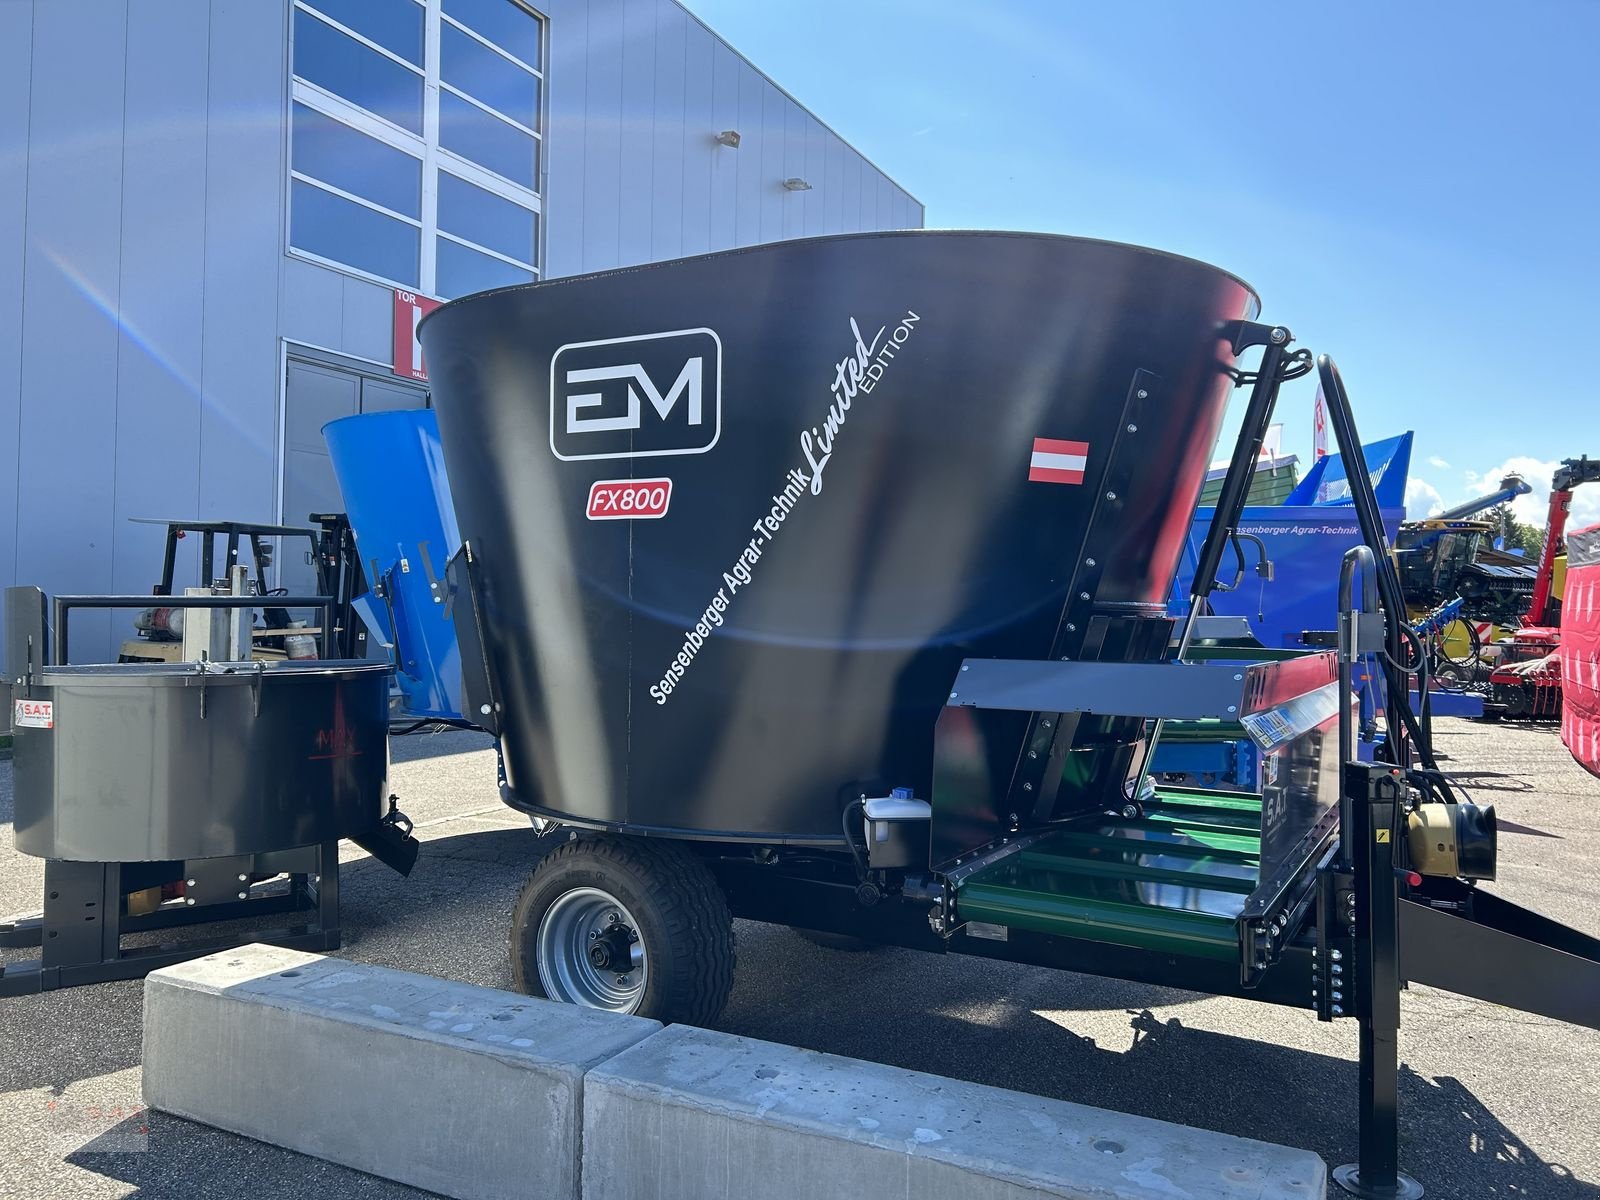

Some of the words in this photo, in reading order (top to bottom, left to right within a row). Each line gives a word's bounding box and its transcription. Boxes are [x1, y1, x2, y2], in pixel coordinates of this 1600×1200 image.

[396, 289, 417, 305] TOR
[412, 370, 429, 380] HALL
[857, 310, 921, 395] EDITION
[566, 356, 703, 434] EM
[800, 316, 886, 496] Limited
[591, 487, 665, 511] FX800
[1290, 525, 1359, 535] Agrar-Technik
[649, 587, 730, 705] Sensenberger
[722, 467, 811, 595] Agrar-Technik
